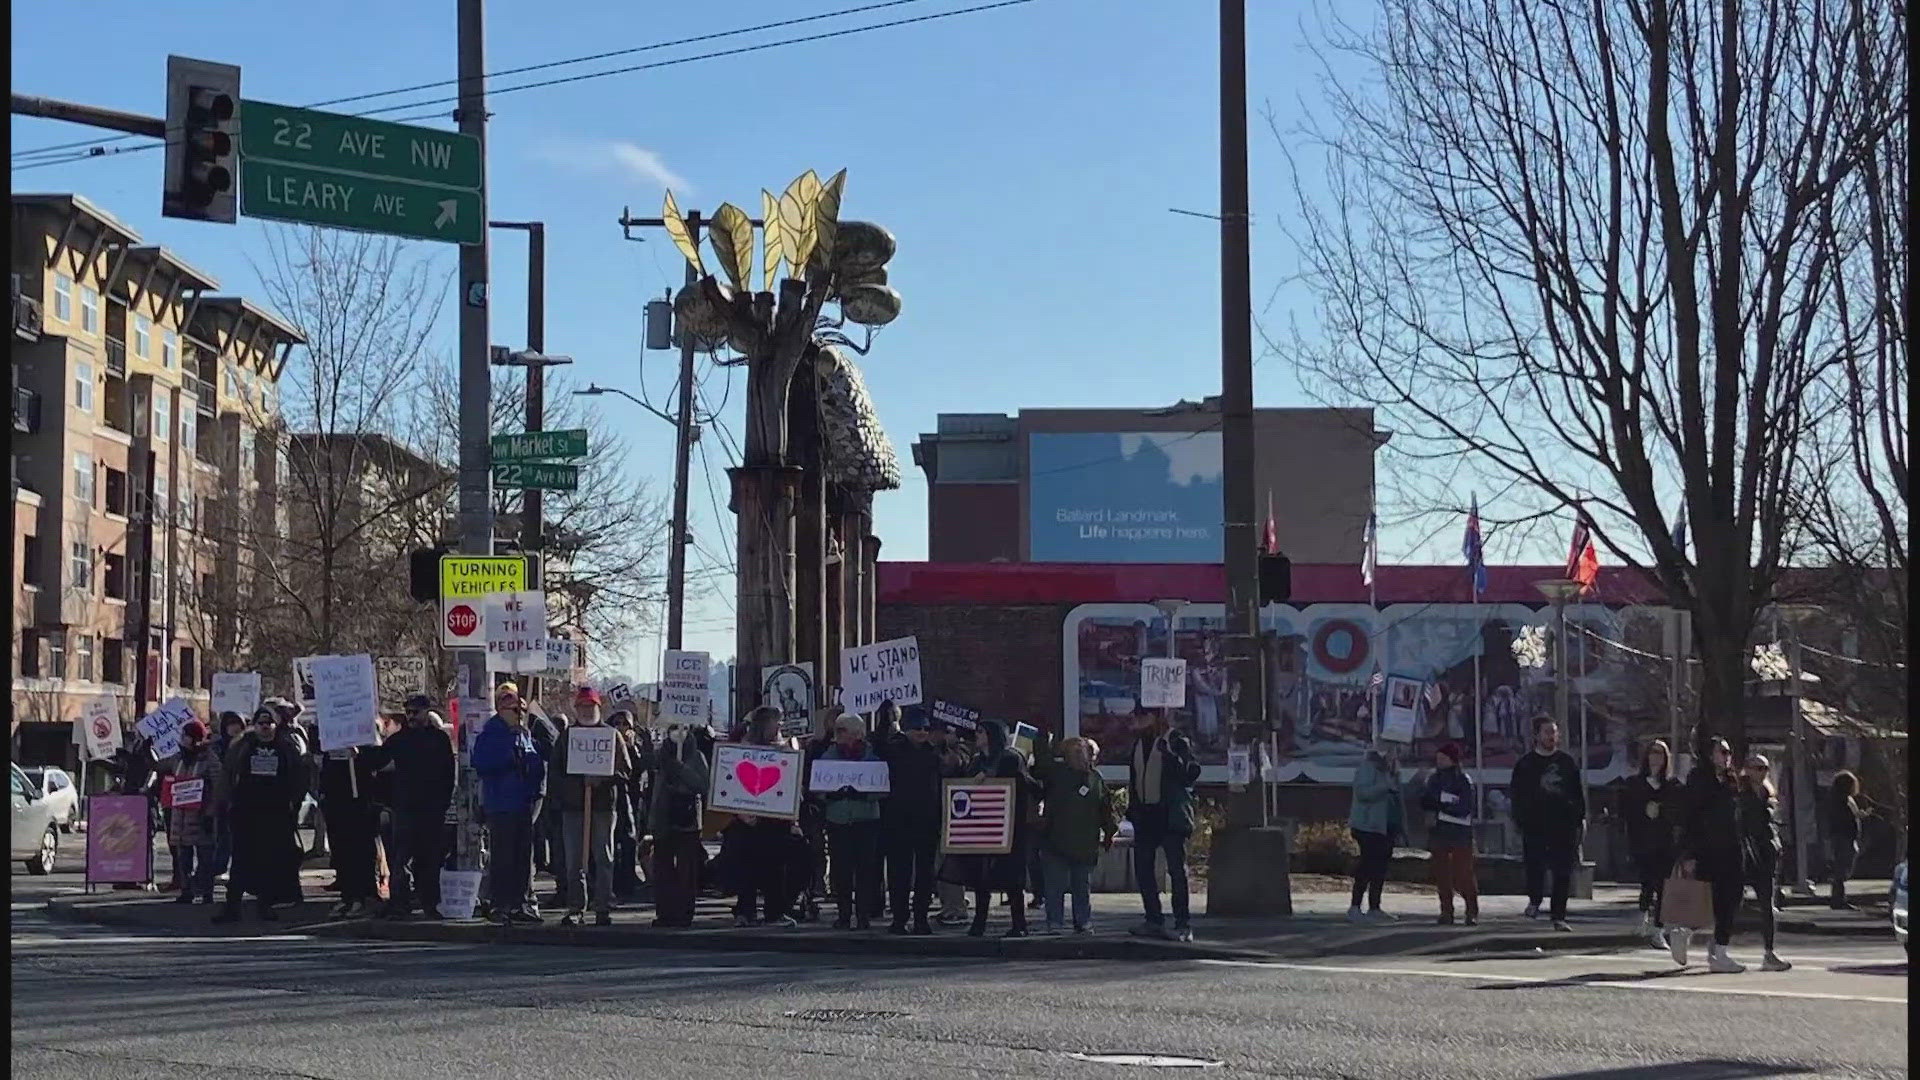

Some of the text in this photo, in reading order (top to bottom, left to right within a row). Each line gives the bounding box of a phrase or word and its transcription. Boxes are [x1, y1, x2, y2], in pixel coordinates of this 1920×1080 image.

[273, 117, 452, 170] 22 AVE NW
[266, 175, 406, 217] LEARY AVE
[511, 433, 555, 457] Market
[535, 469, 555, 485] Ave
[557, 470, 575, 485] NW
[1056, 508, 1103, 522] Ballard
[1079, 524, 1107, 539] Life
[1111, 525, 1172, 541] happens
[450, 563, 517, 576] TURNING
[452, 581, 516, 594] VEHICLES
[504, 601, 523, 612] WE
[449, 614, 476, 627] STOP
[503, 620, 528, 631] THE
[489, 639, 542, 652] PEOPLE
[676, 659, 702, 670] ICE
[850, 647, 917, 674] WE STAND
[870, 665, 904, 684] WITH
[1144, 664, 1184, 684] TRUMP
[855, 684, 919, 707] MINNESOTA
[674, 703, 700, 716] ICE
